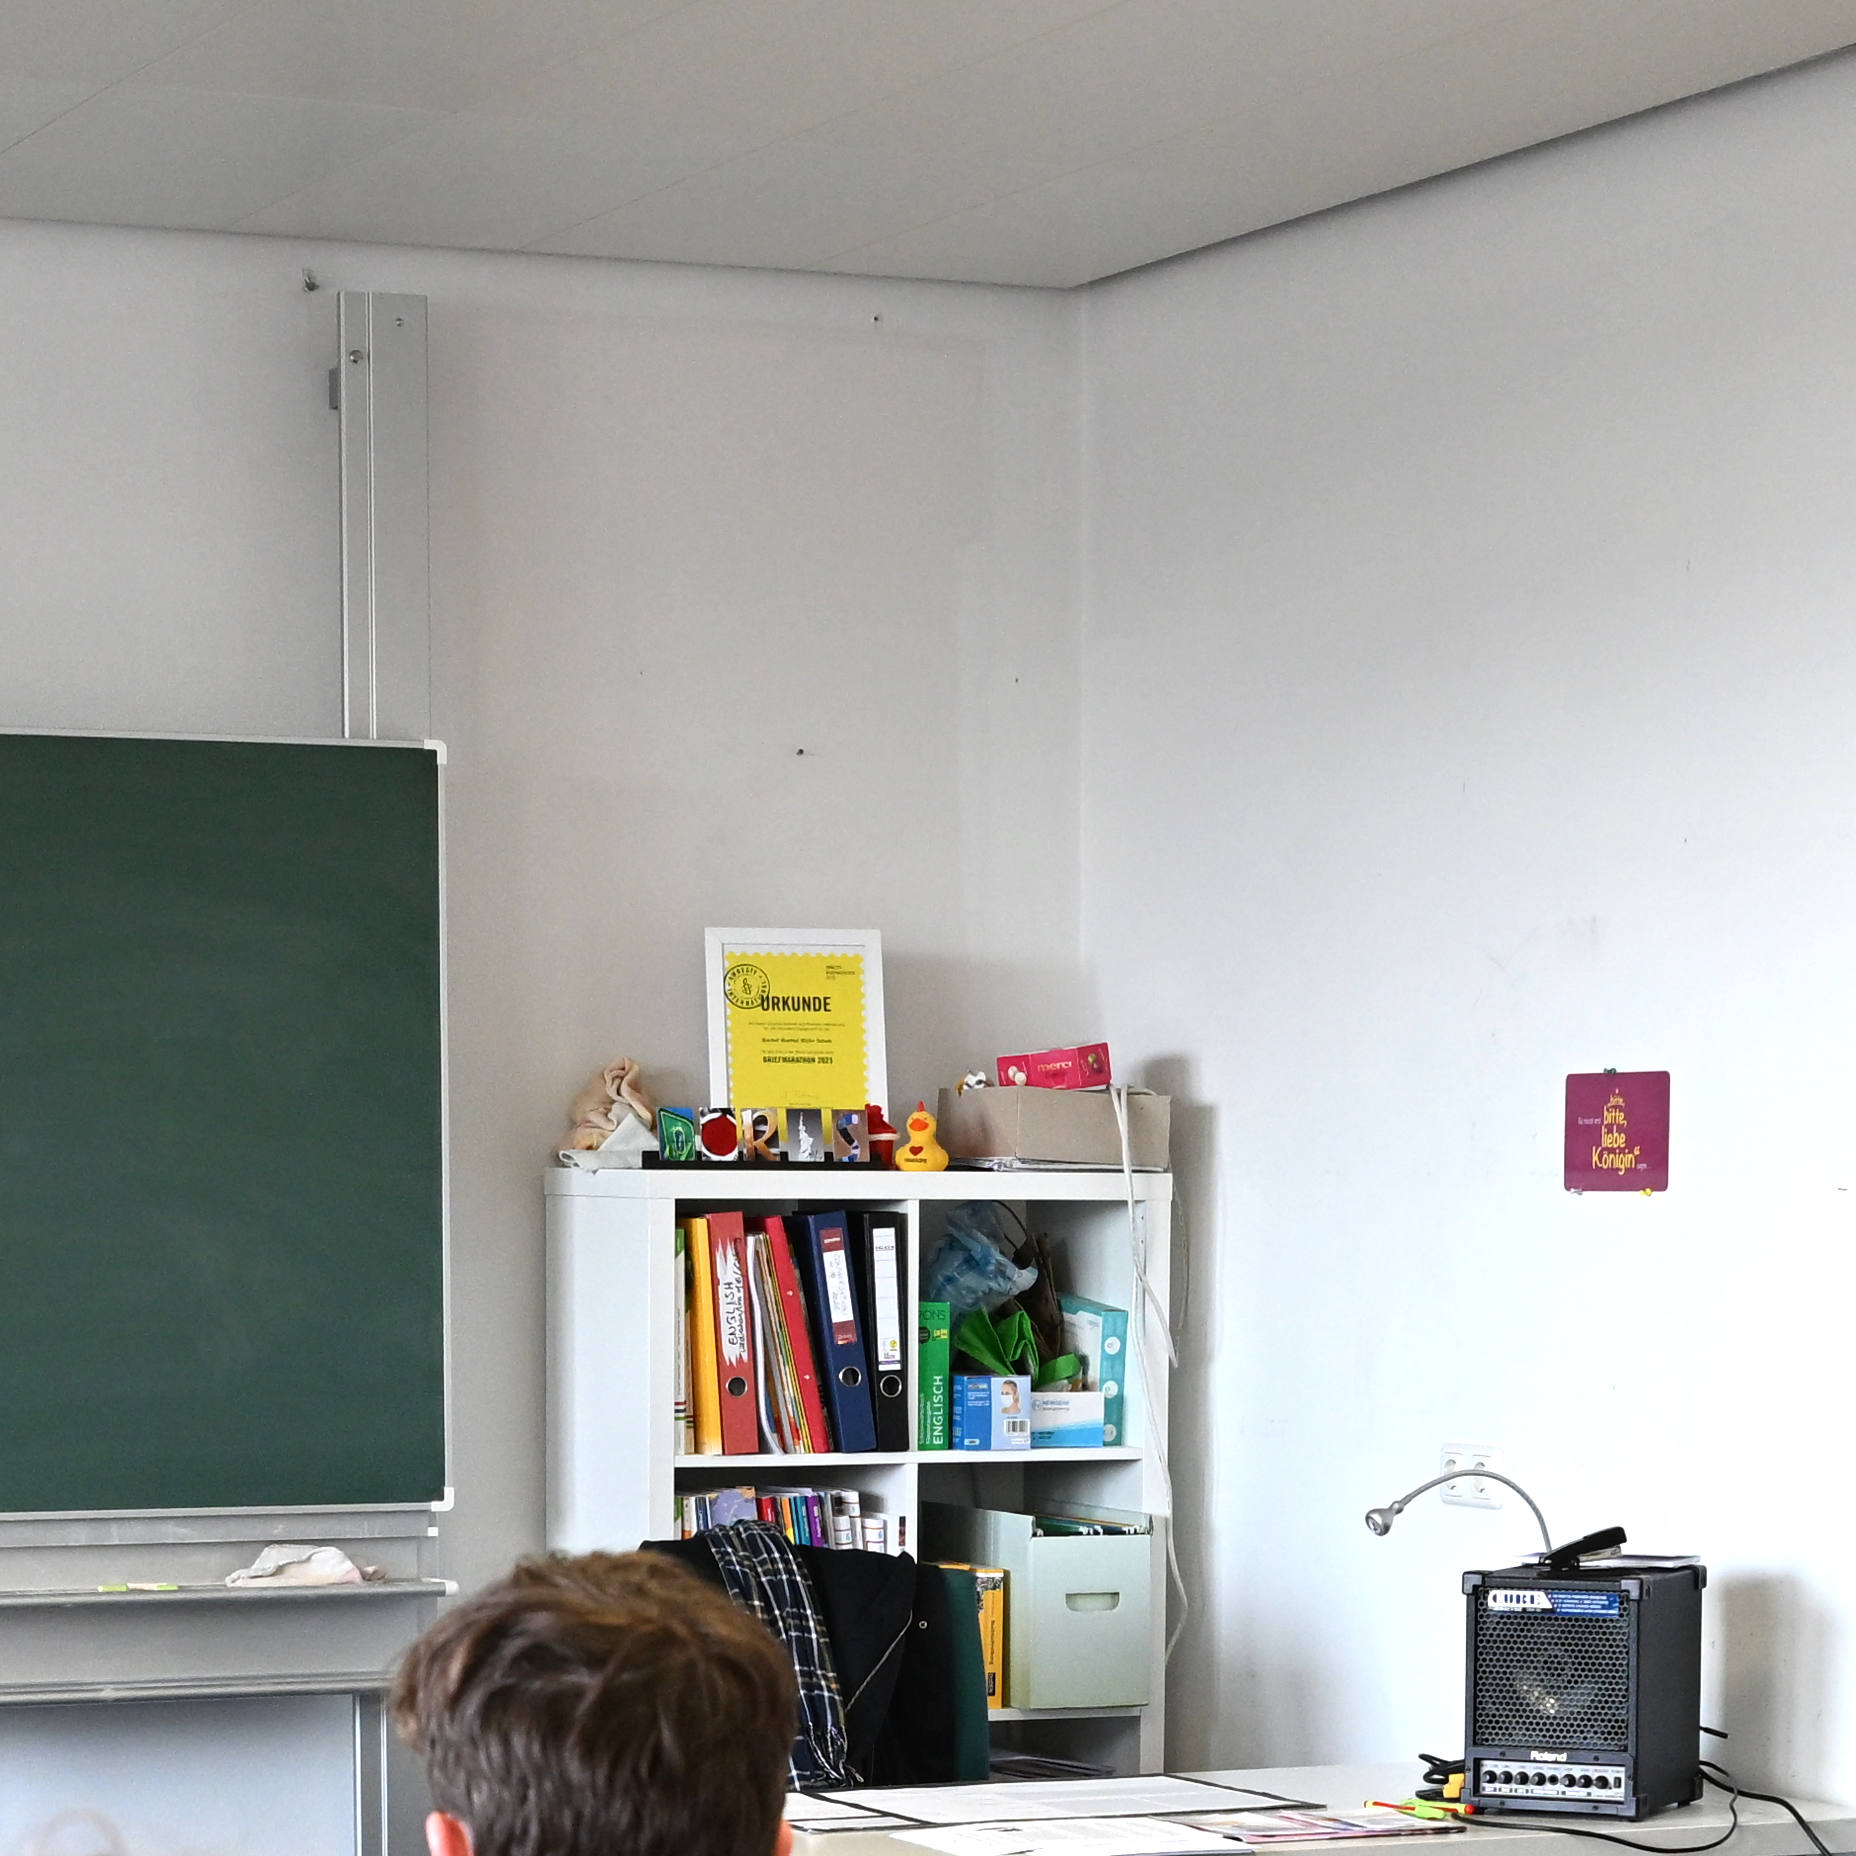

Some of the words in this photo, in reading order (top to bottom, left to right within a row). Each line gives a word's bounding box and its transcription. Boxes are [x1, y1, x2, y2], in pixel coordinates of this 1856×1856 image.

[760, 995, 832, 1012] URKUNDE
[1037, 1060, 1073, 1072] merci
[1603, 1105, 1628, 1127] bitte,
[1601, 1124, 1626, 1148] liebe
[723, 1280, 739, 1346] ENGLISH
[933, 1375, 943, 1445] ENGLISCH
[1530, 1750, 1568, 1763] Roland
